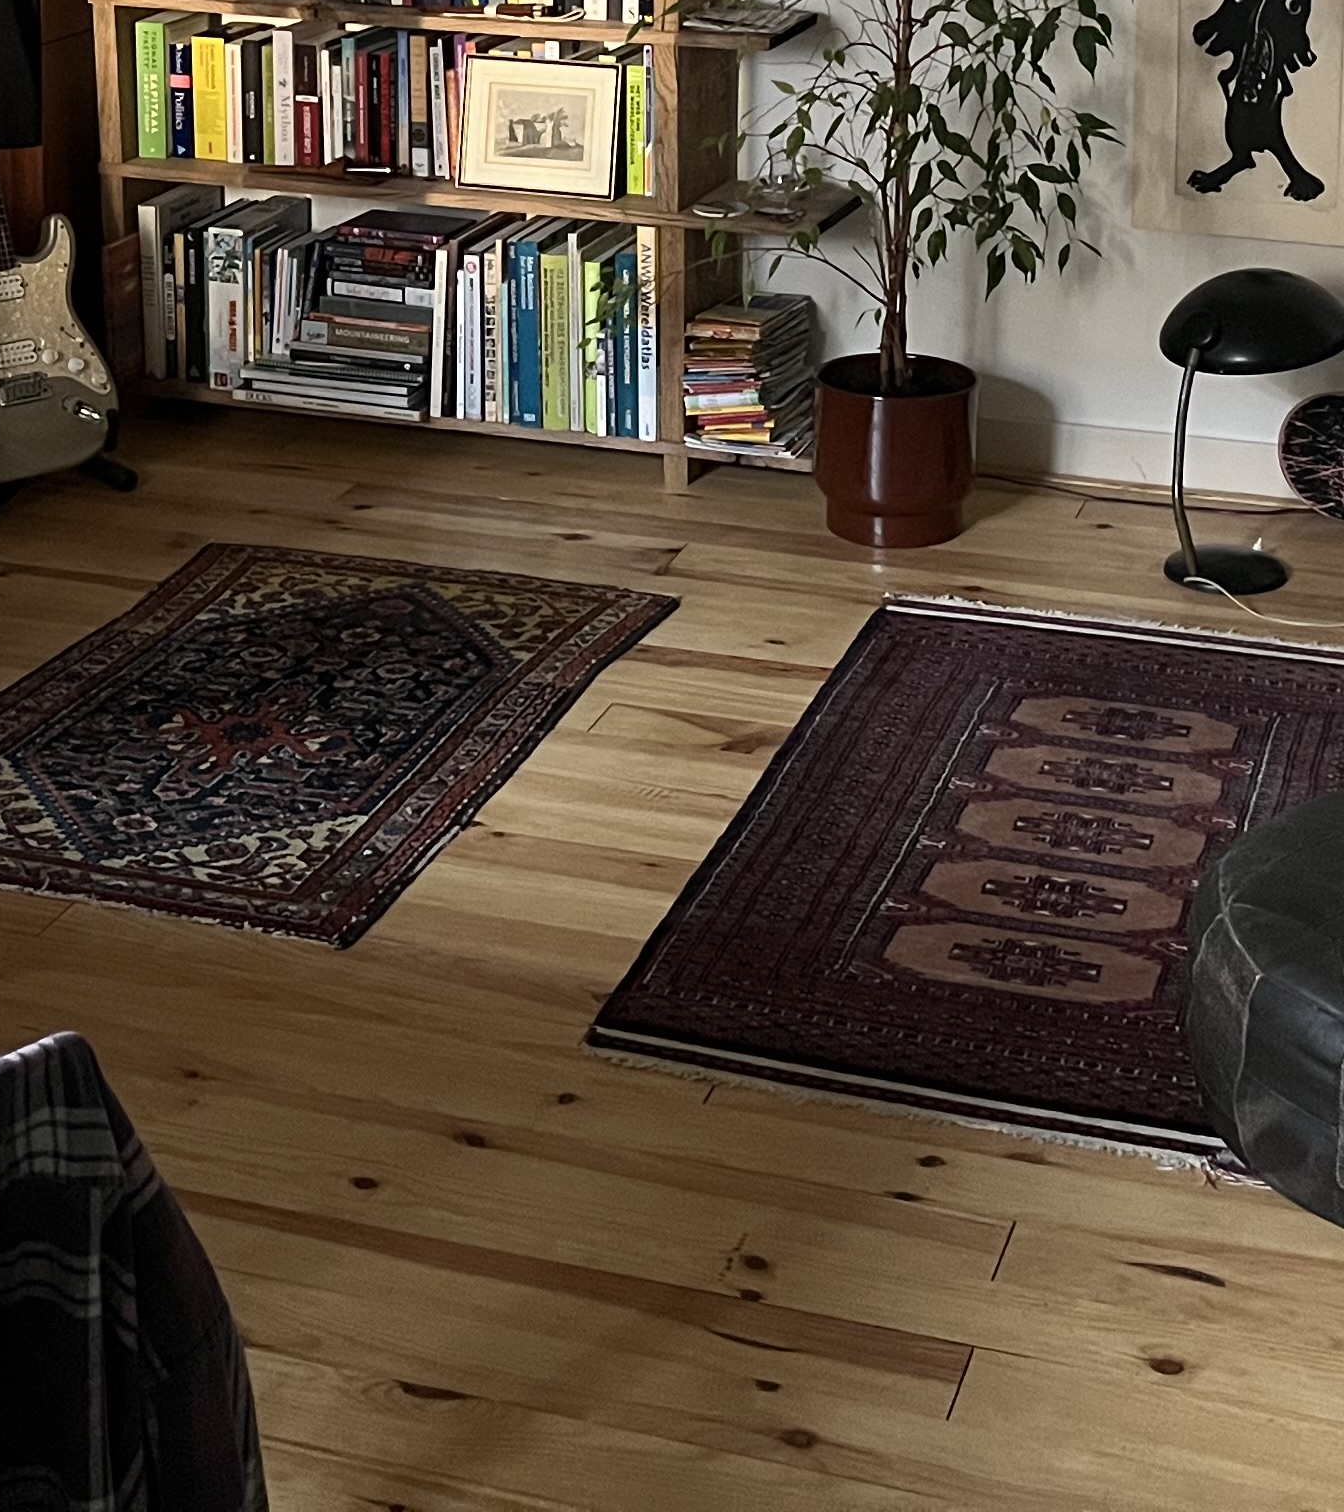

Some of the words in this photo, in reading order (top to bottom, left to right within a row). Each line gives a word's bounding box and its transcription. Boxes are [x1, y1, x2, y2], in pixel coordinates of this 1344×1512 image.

[142, 30, 150, 69] PIKETTY
[150, 73, 159, 134] KAPITAAL
[174, 91, 185, 130] Politics
[278, 95, 291, 143] Mythos
[335, 328, 410, 344] MOUNTAINEERING
[640, 291, 654, 371] Wereldatlas
